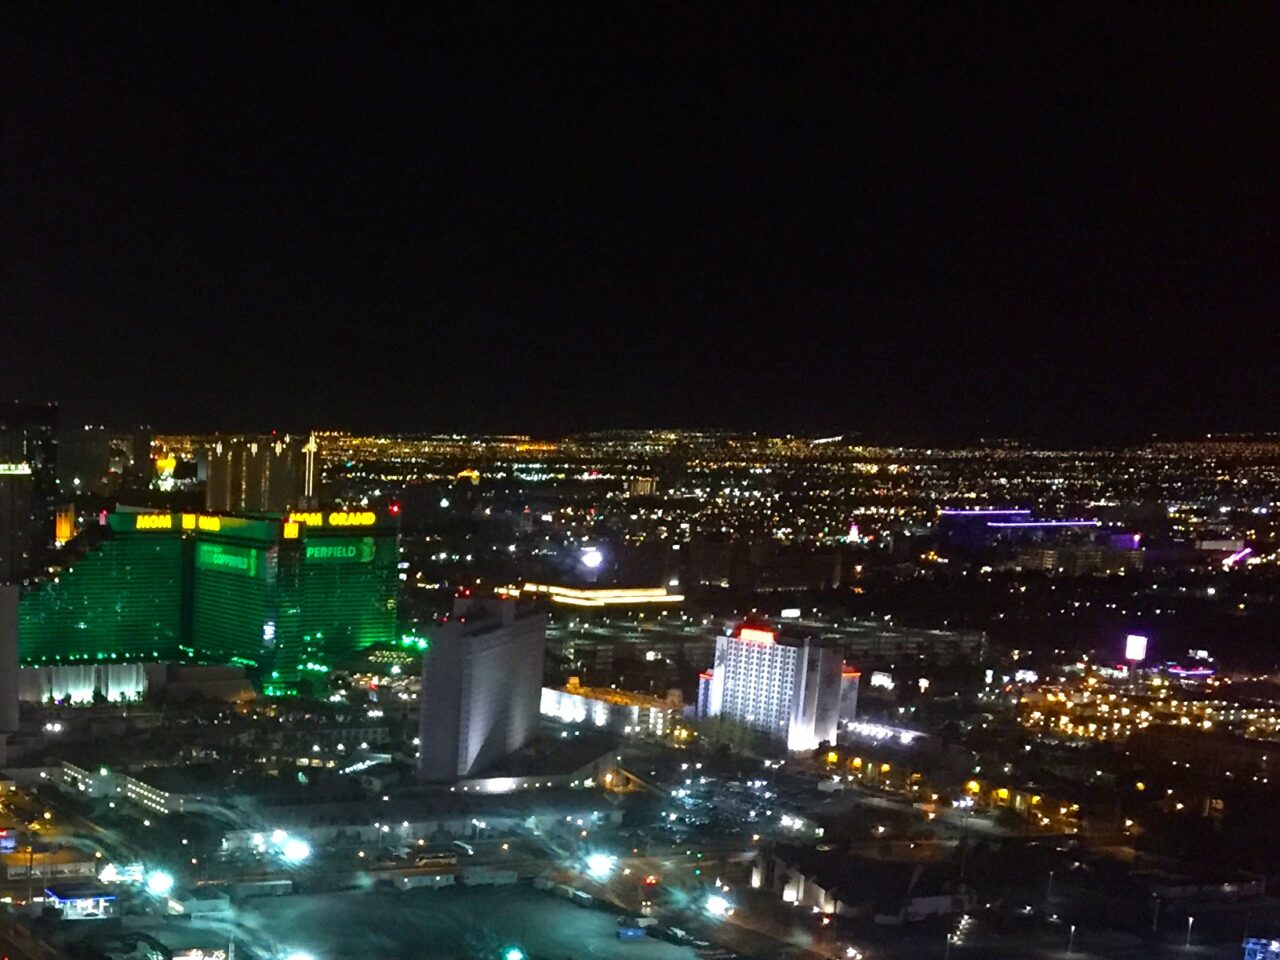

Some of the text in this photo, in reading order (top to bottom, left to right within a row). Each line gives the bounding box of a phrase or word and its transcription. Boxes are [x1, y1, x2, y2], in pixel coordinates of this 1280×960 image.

[136, 514, 172, 529] MGM
[328, 511, 376, 526] GRAND
[306, 546, 357, 558] PERFIELD
